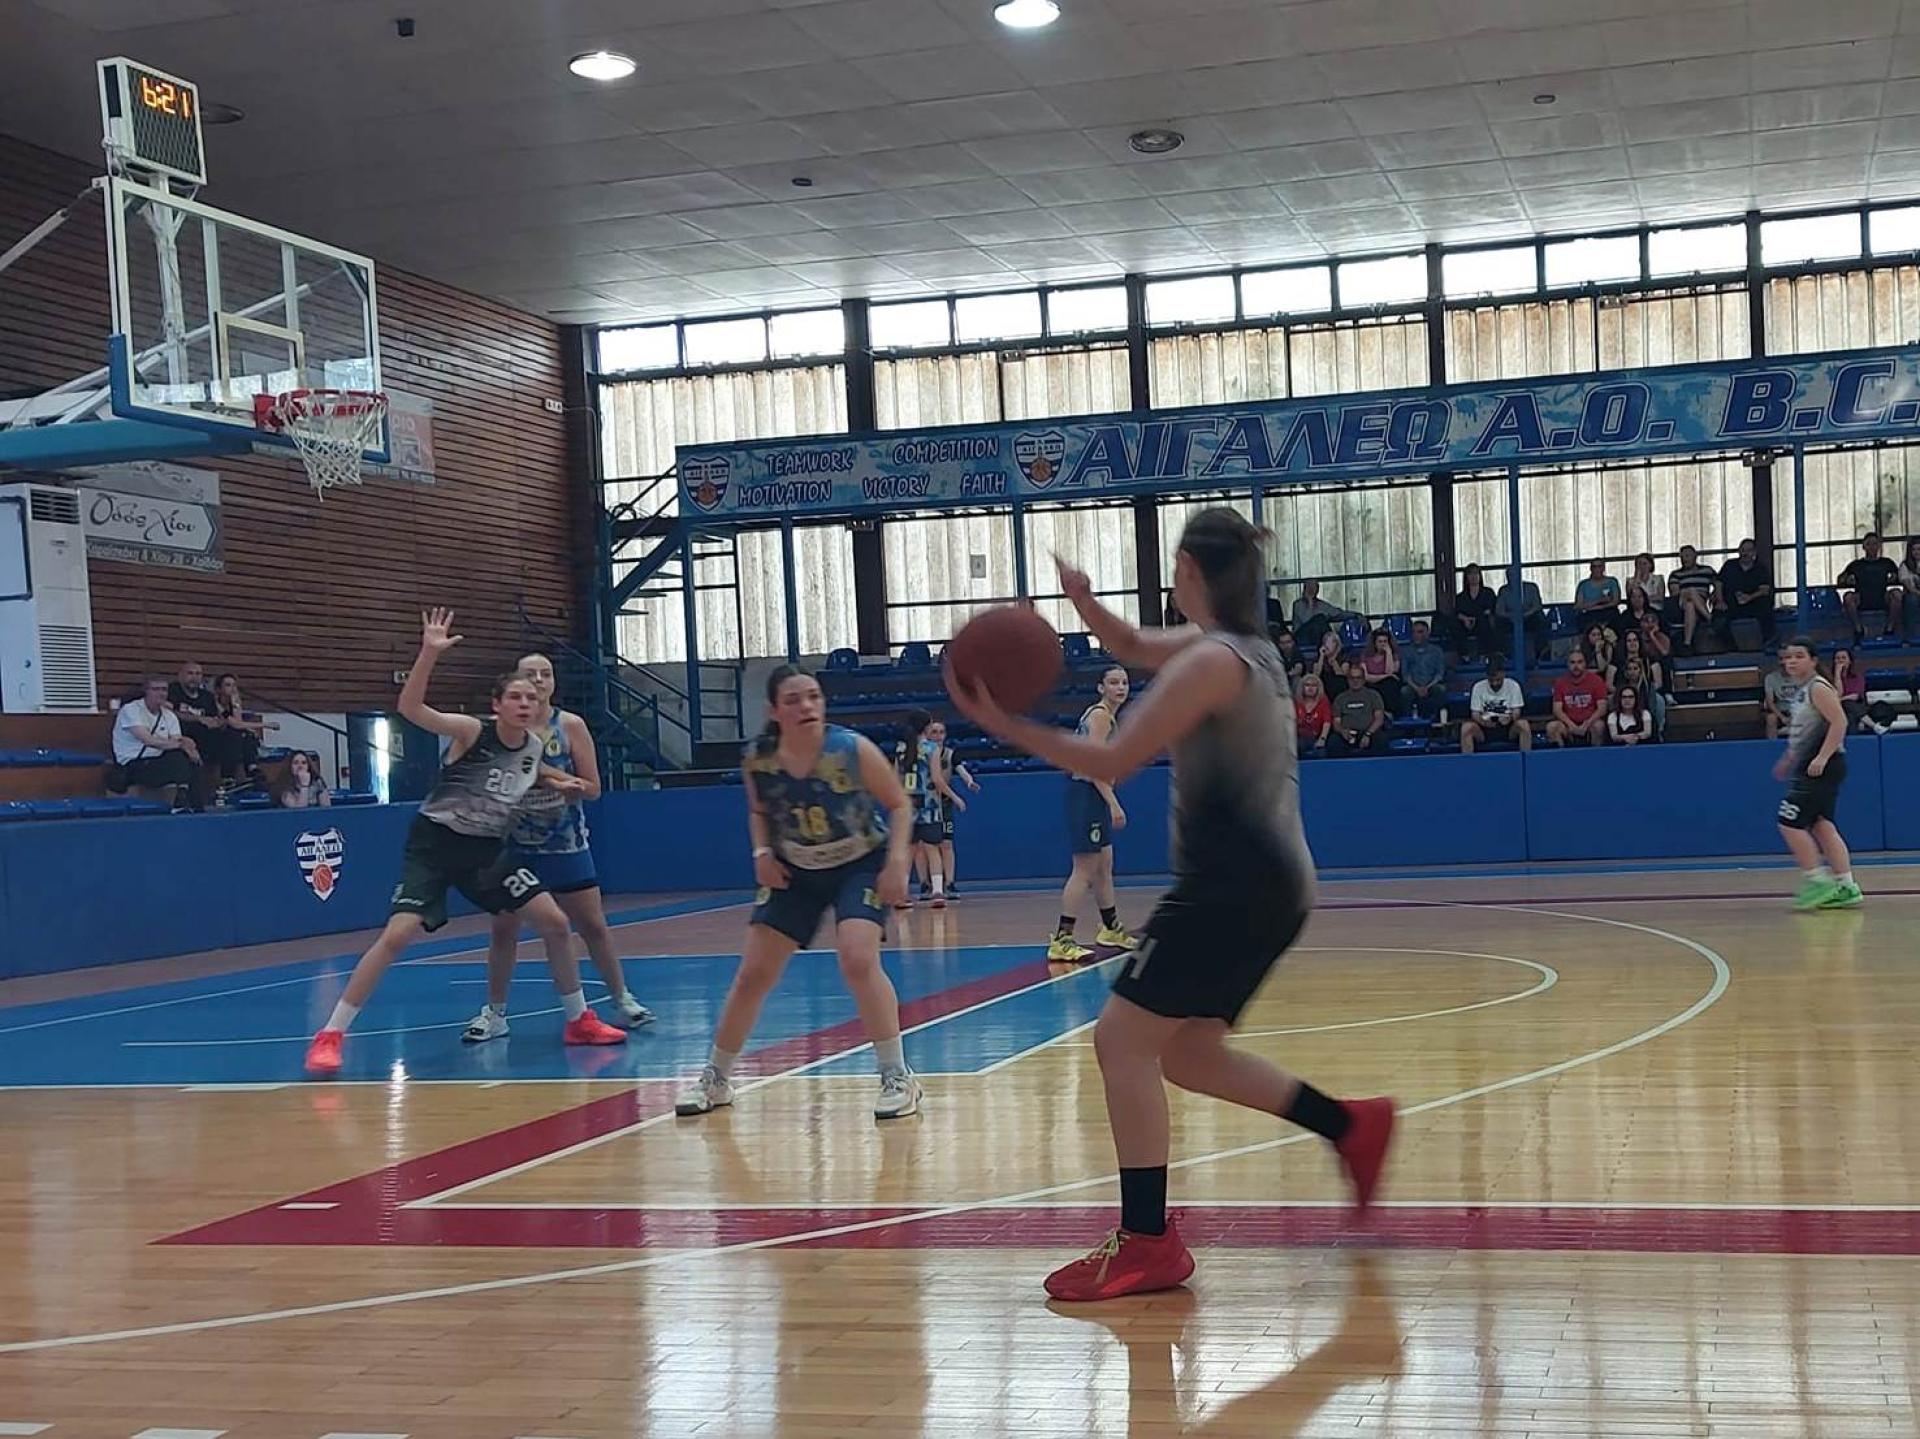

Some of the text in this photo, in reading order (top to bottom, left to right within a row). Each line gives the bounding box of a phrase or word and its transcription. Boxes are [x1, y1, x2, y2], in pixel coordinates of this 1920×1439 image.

[142, 76, 190, 118] 6:21
[766, 437, 999, 475] TEAMWORK COMPETITION
[738, 471, 1007, 507] MOTIVATION VICTORY FAITH
[503, 868, 540, 898] 20
